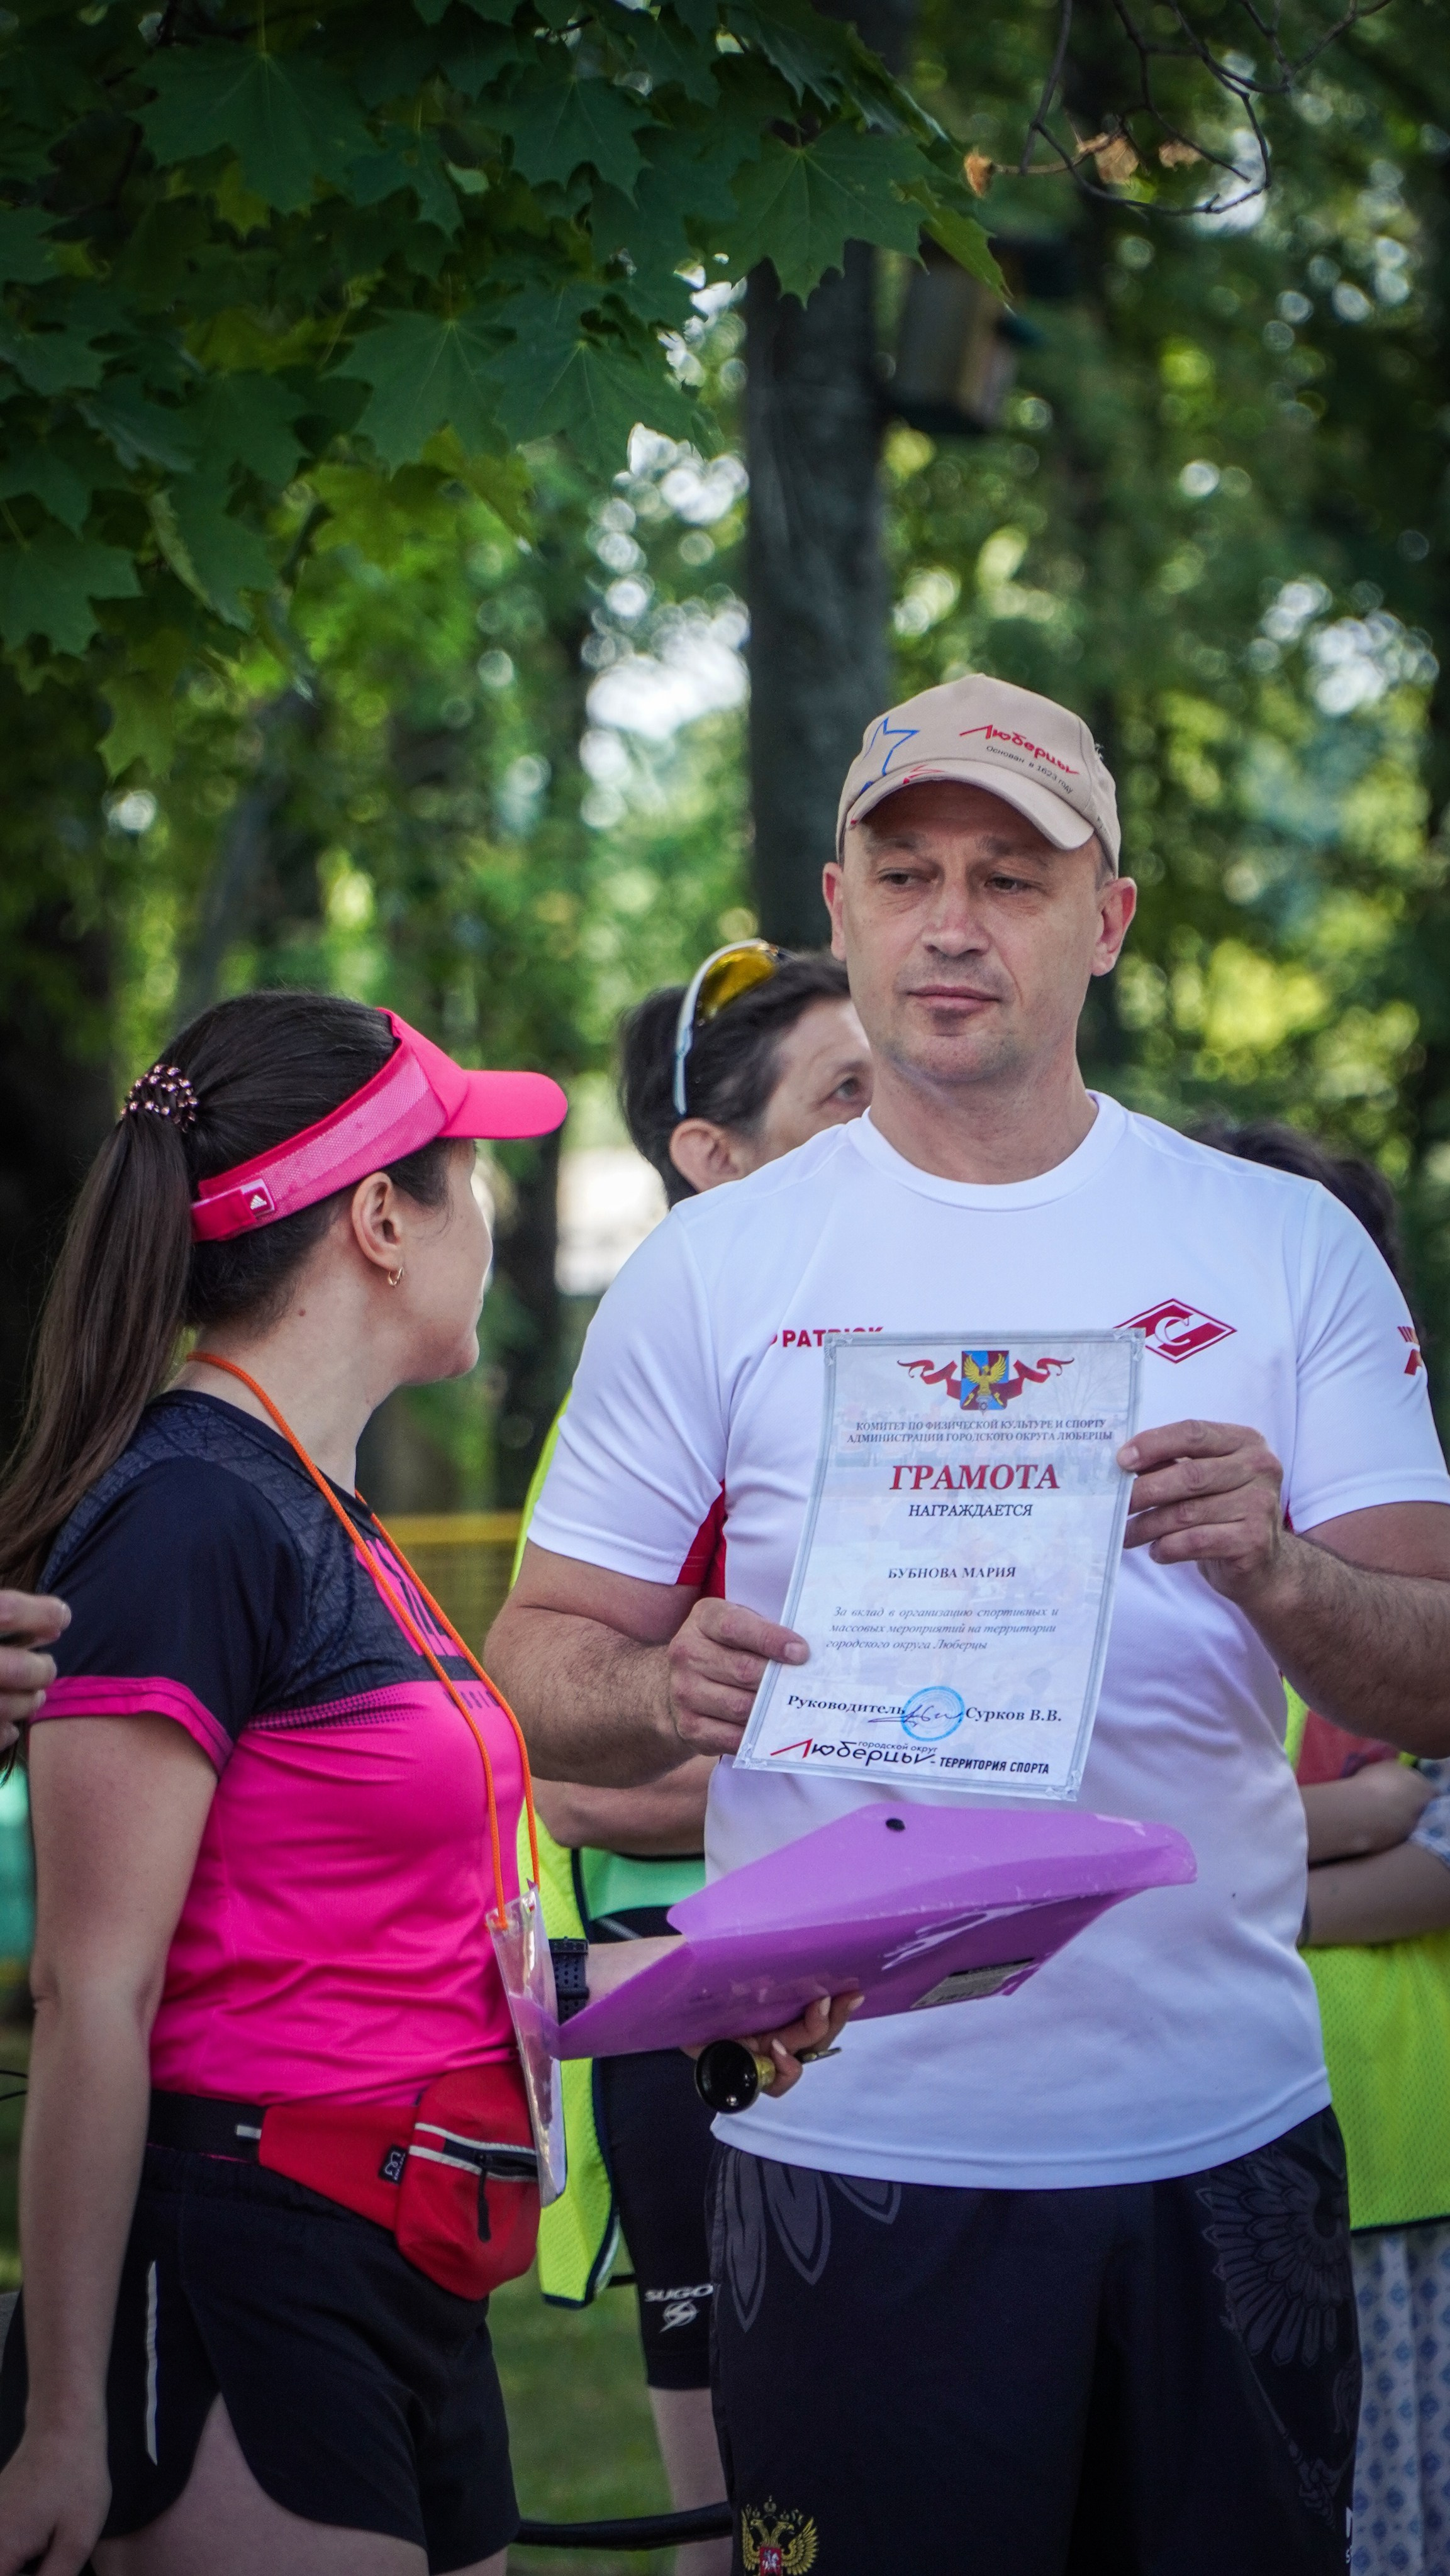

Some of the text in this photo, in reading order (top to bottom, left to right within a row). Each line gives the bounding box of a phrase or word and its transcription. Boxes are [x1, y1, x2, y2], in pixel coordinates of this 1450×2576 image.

[959, 724, 1079, 775] Люберцы
[986, 745, 1025, 763] Основан
[1037, 765, 1057, 781] 1623
[856, 1419, 1107, 1431] КОМИТЕТ ПО ФИЗИЧЕСКОЙ КУЛЬТУРЕ И СПОРТУ
[847, 1431, 1113, 1443] АДМИНИСТРАЦИИ ГОРОДСКОГО ОКРУГА ЛЮБЕРЦЫ
[889, 1463, 1061, 1490] ГРАМОТА
[908, 1504, 1033, 1518] НАГРАЖДАЕТСЯ
[888, 1567, 1016, 1579] БУБНОВА МАРИЯ
[834, 1606, 847, 1617] За
[851, 1607, 884, 1617] вклад
[899, 1609, 973, 1619] организацию
[977, 1608, 1047, 1619] спортивных
[1051, 1608, 1059, 1616] и
[829, 1624, 886, 1633] массовых
[886, 1623, 966, 1635] мероприятий
[983, 1625, 1057, 1636] территории
[826, 1639, 988, 1652] городского округа Люберцы
[787, 1694, 1062, 1723] Руководитель Сурков В.В.
[858, 1740, 938, 1755] городской округ
[770, 1738, 936, 1766] Люберцы
[940, 1757, 1007, 1772] ТЕРРИТОРИЯ
[1010, 1762, 1049, 1774] СПОРТА
